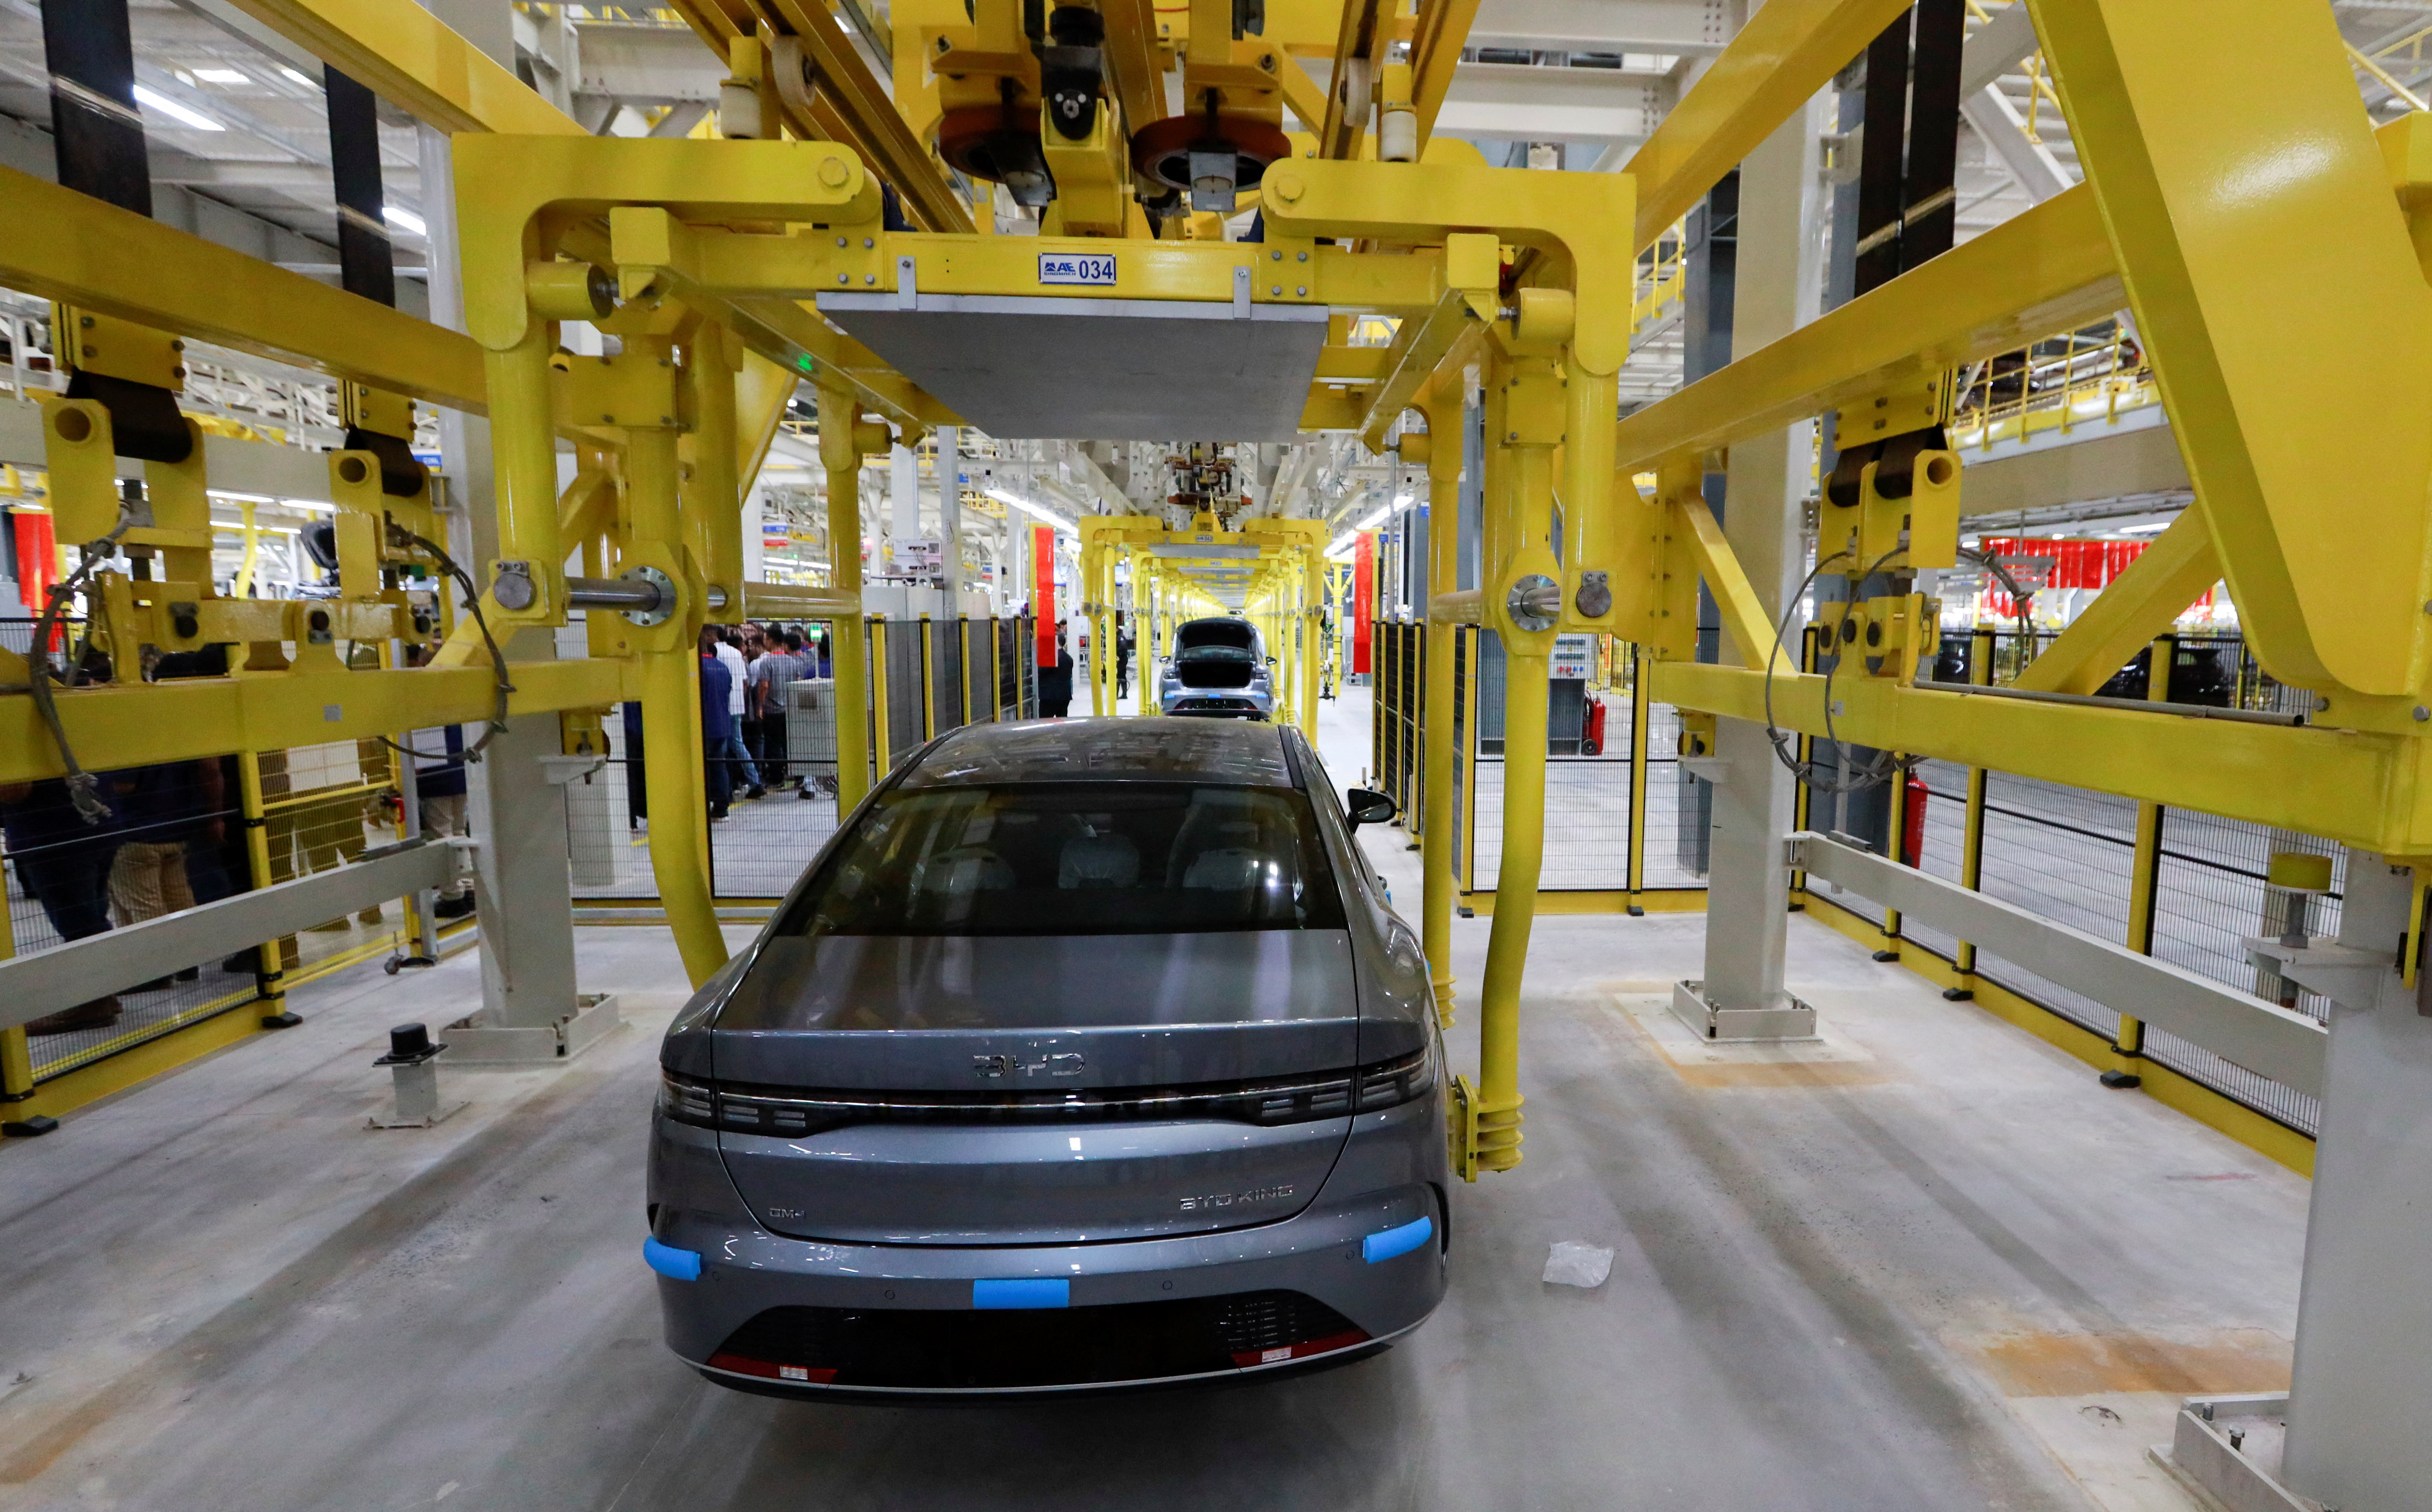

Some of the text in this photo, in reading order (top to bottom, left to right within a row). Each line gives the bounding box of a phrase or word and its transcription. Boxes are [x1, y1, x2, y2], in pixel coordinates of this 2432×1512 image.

[1079, 260, 1112, 279] 034
[973, 1053, 1085, 1077] BYD
[1180, 1185, 1292, 1210] BYD KING
